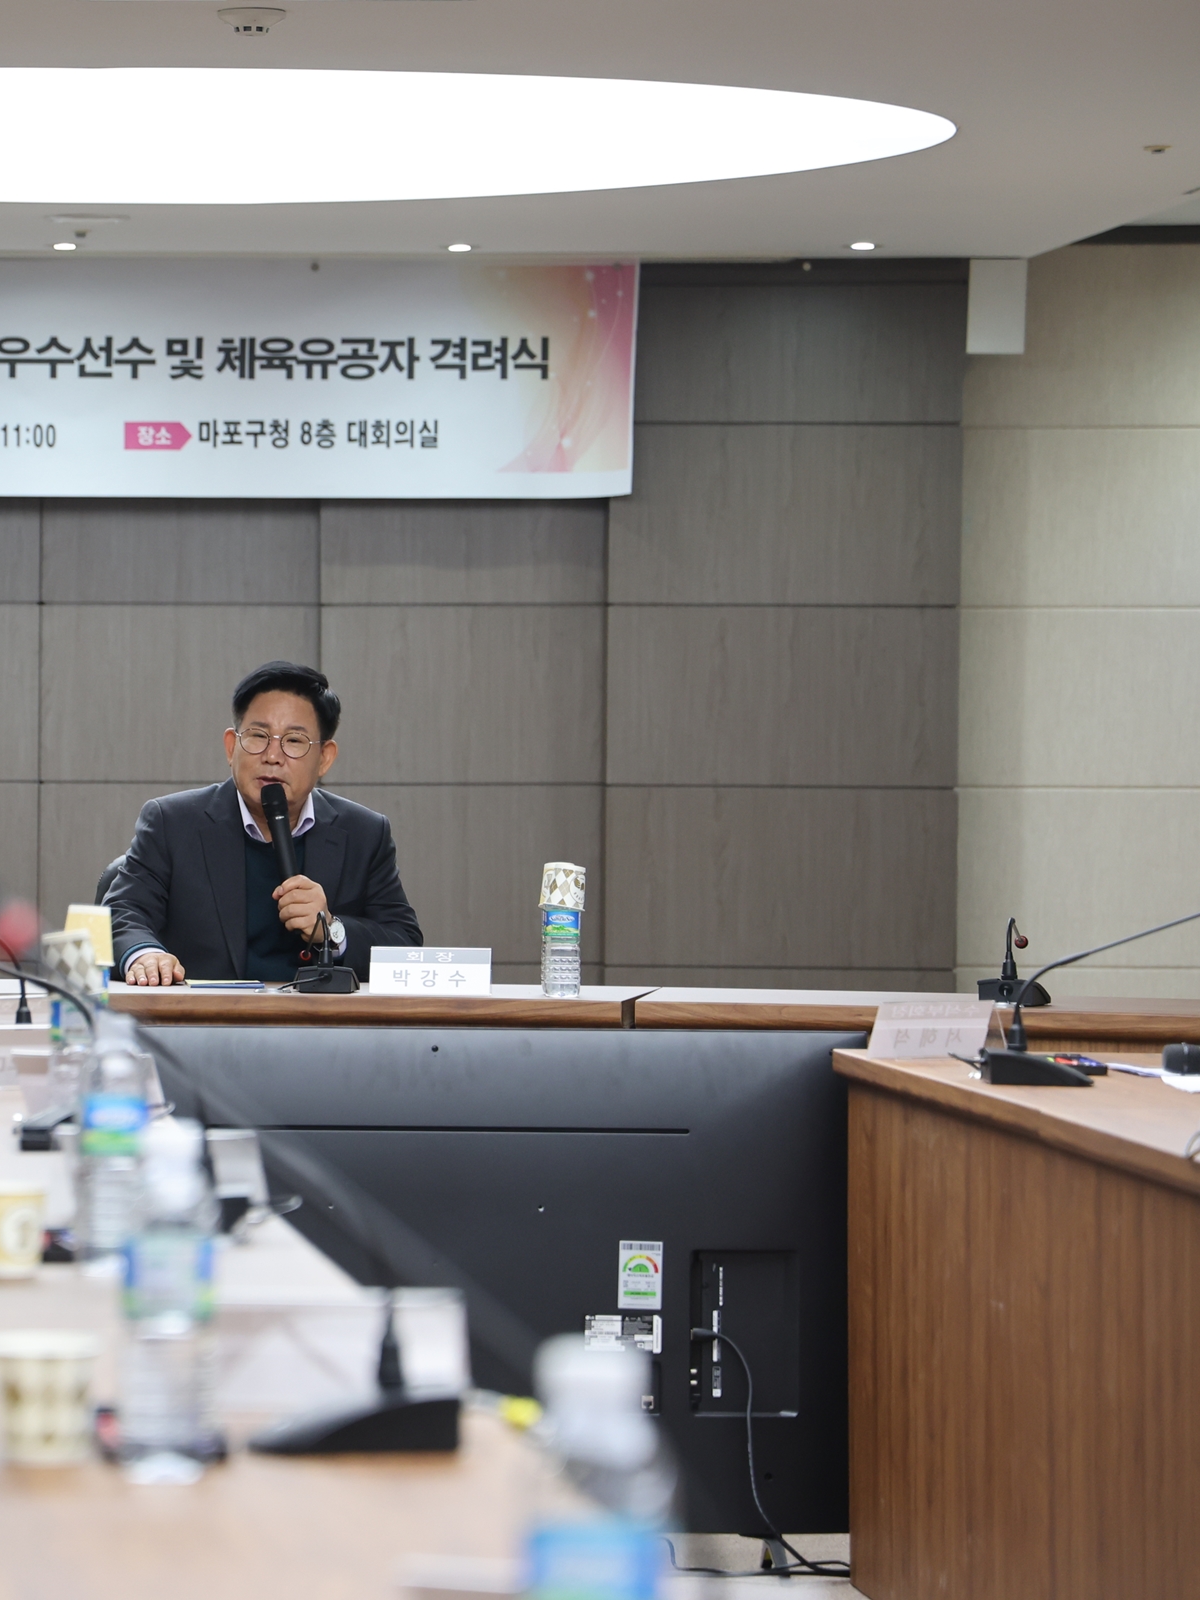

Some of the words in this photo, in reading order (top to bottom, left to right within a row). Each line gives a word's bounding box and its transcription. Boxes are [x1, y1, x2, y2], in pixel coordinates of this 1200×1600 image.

[165, 336, 205, 379] 및
[216, 335, 420, 380] 체육유공자
[429, 336, 550, 380] 격려식
[1, 423, 57, 448] 11:00
[137, 425, 172, 446] 장소
[198, 419, 290, 449] 마포구청
[300, 420, 337, 449] 8층
[347, 419, 439, 448] 대회의실
[406, 951, 455, 963] 회장
[392, 969, 467, 988] 박강수
